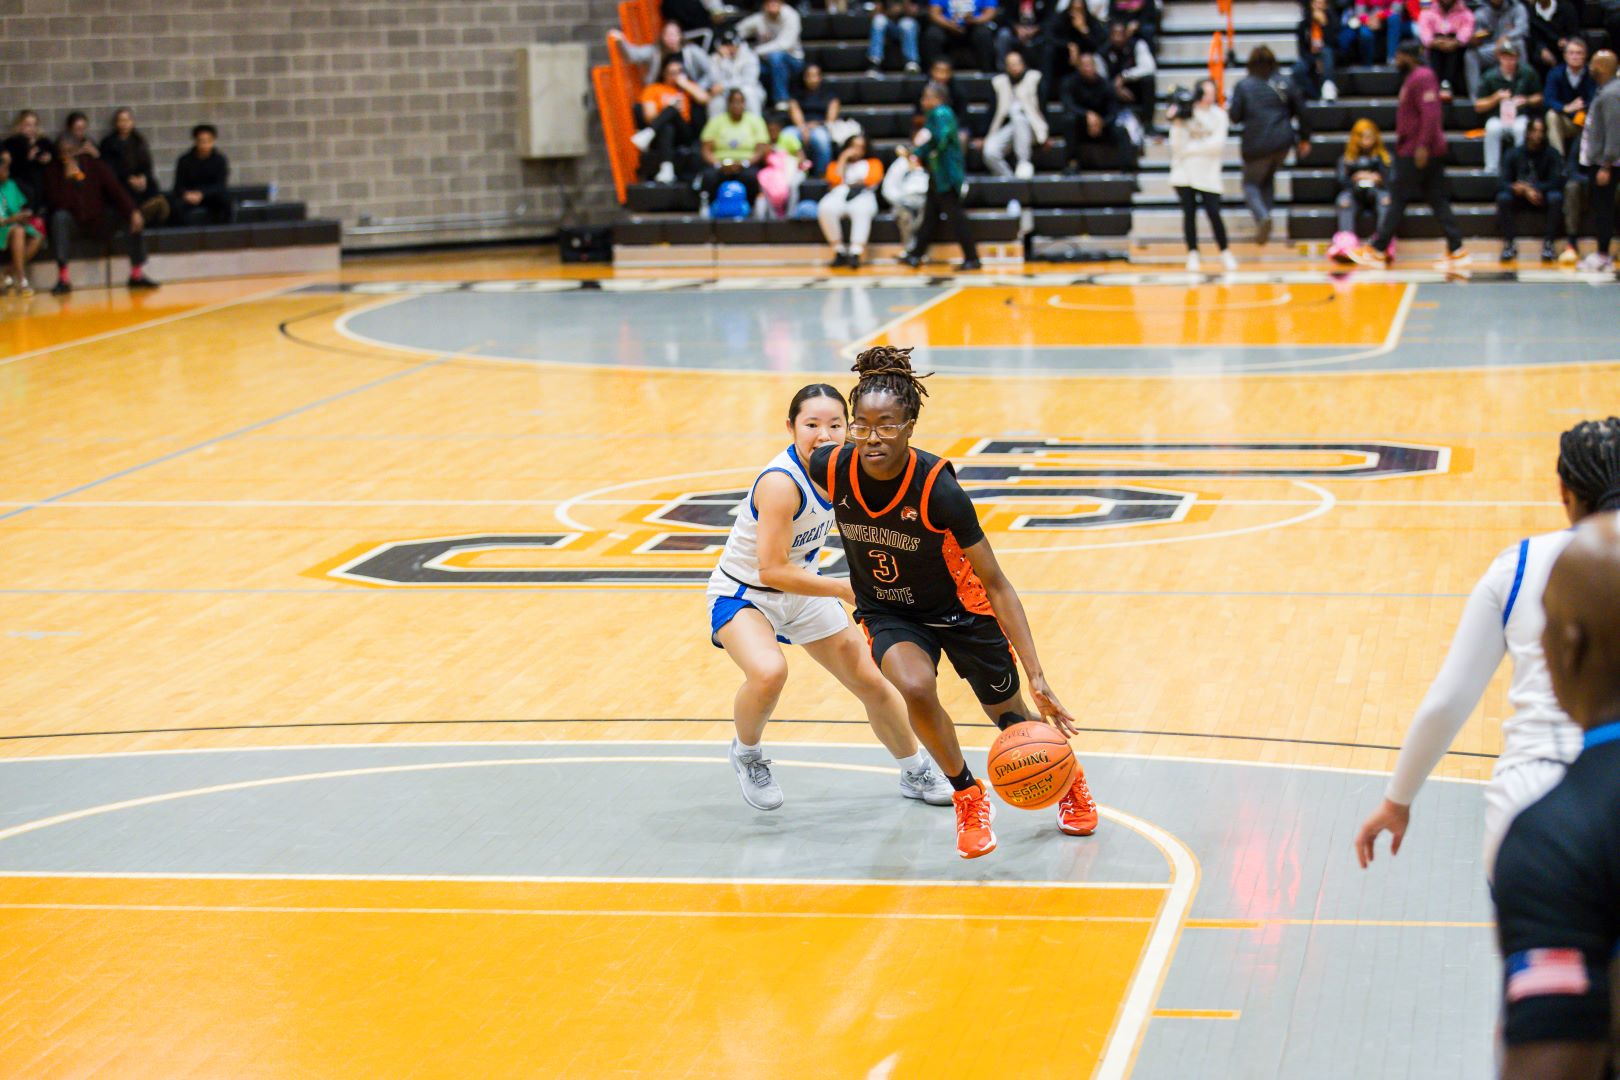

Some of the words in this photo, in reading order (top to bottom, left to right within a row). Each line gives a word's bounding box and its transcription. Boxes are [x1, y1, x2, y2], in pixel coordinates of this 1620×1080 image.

[791, 521, 825, 548] GREAT
[868, 549, 900, 583] 3
[994, 749, 1050, 780] SPALDING
[1005, 773, 1053, 798] LEGACY
